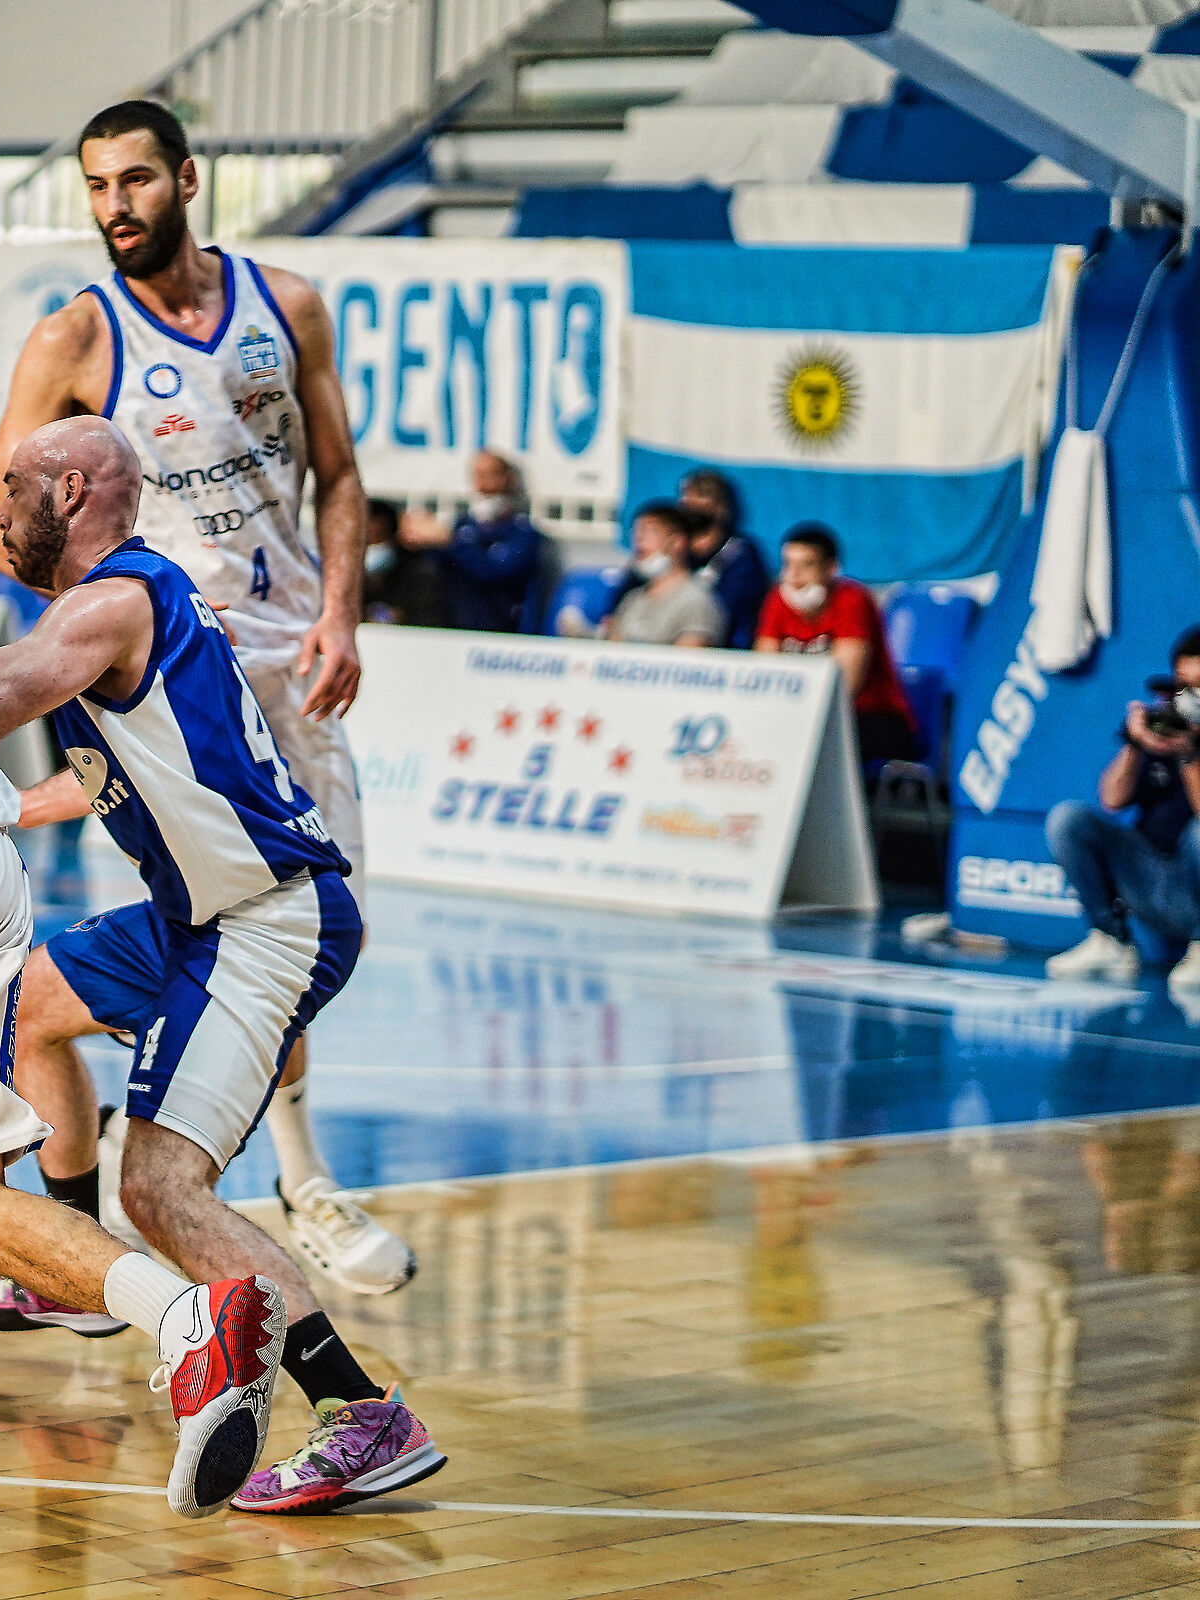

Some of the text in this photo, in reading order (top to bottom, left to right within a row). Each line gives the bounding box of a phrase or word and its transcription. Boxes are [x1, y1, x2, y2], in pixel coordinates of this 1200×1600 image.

[337, 277, 605, 457] GENTO
[250, 546, 271, 601] 4
[524, 741, 555, 780] 5
[668, 713, 728, 760] 10
[431, 777, 625, 833] STELLE
[959, 855, 1079, 898] SPOR
